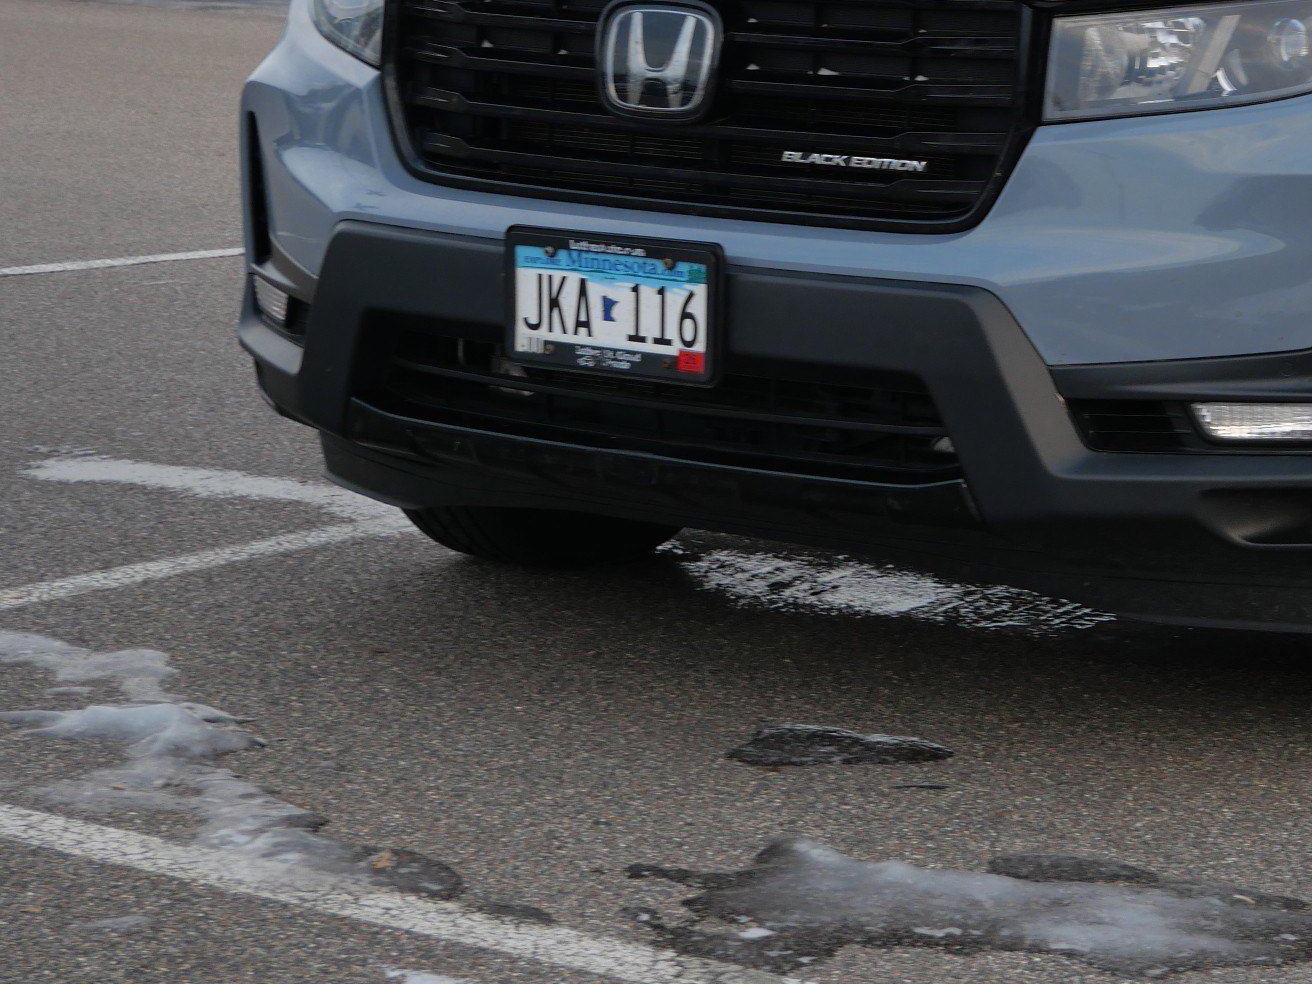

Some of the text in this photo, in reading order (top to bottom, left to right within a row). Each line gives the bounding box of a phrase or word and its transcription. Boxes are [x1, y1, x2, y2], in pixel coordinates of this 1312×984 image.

[781, 151, 928, 172] BLACK EDITION
[524, 273, 698, 349] JKA 116
